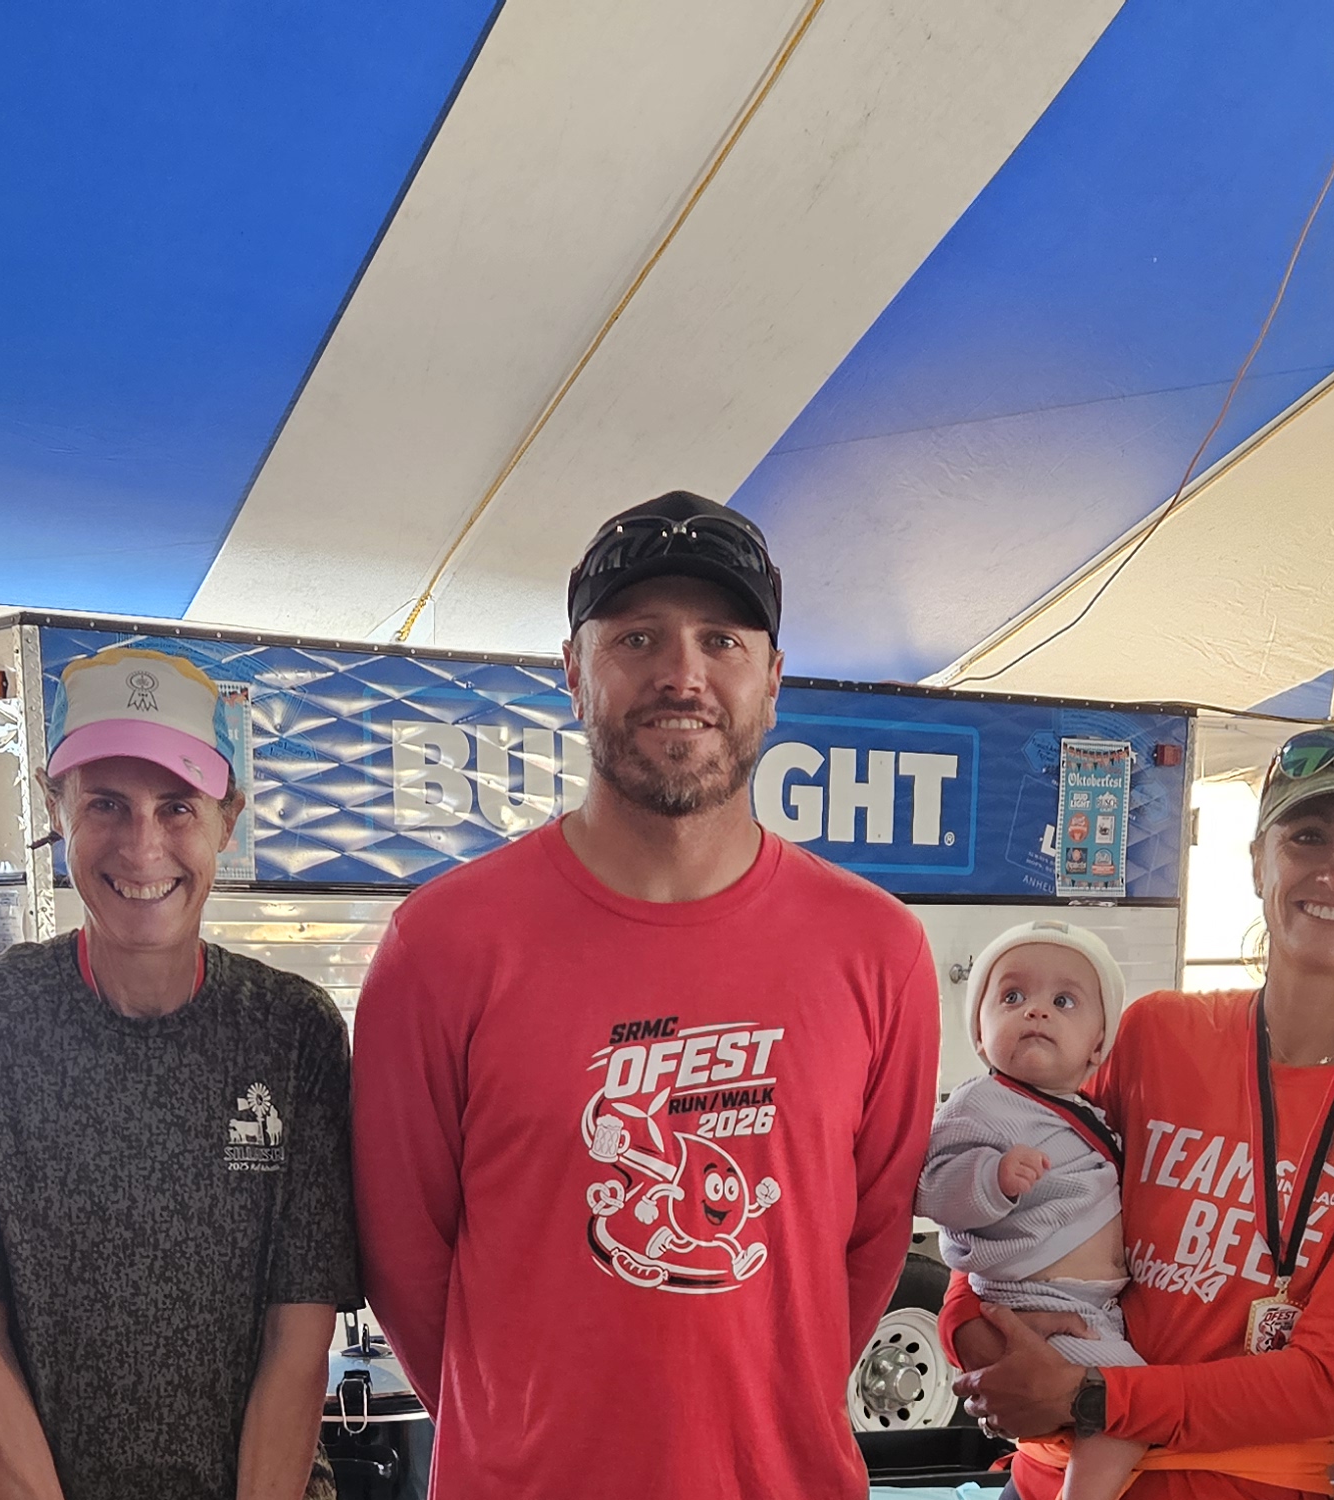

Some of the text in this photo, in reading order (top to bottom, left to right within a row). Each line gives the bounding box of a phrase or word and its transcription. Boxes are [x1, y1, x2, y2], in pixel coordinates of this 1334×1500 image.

[754, 741, 958, 846] GHT
[1068, 773, 1122, 788] Oktoberfest
[1023, 875, 1055, 894] ANHEU
[609, 1016, 678, 1044] SRMC
[603, 1028, 784, 1099] OFEST
[697, 1105, 776, 1138] 2026
[1140, 1119, 1255, 1204] TEAM
[1264, 1311, 1298, 1321] OFEST
